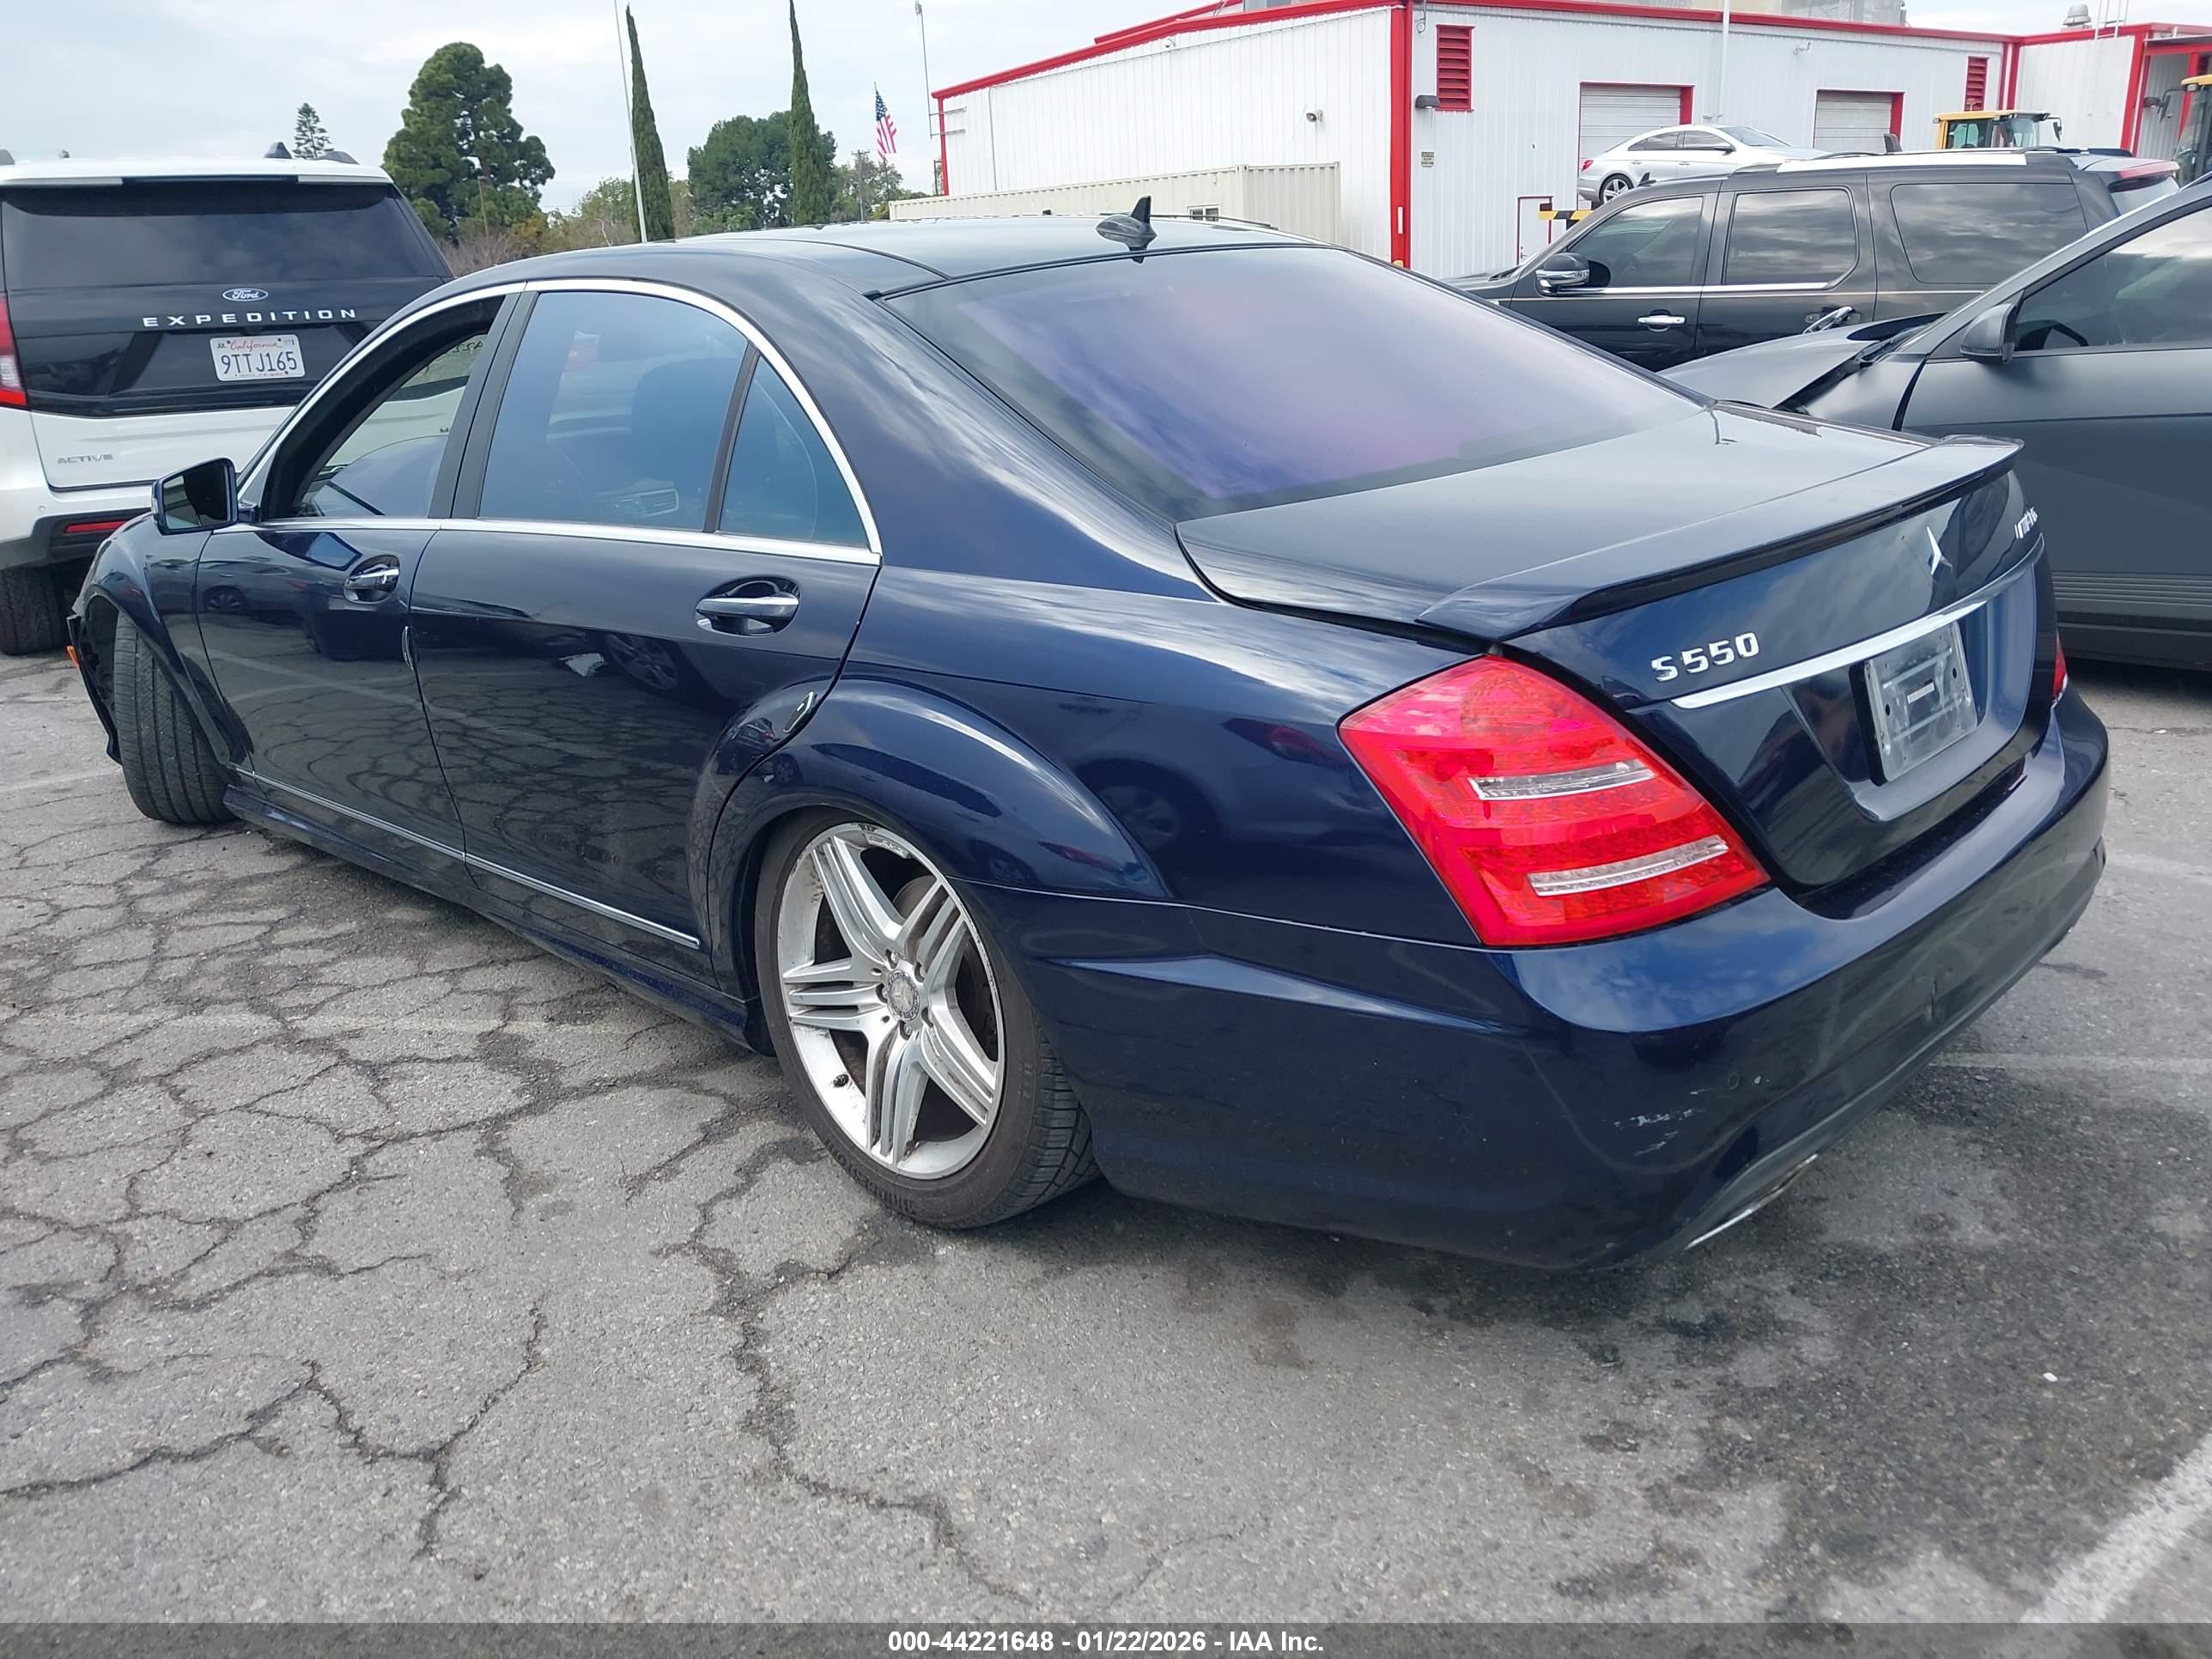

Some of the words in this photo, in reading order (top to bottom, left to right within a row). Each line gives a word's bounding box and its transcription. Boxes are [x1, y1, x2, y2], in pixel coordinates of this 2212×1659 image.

[232, 289, 260, 300] Ford
[143, 309, 356, 327] EXPEDITION
[230, 340, 277, 352] California
[221, 351, 297, 374] 9TTJ165
[57, 453, 113, 465] ACTIVE
